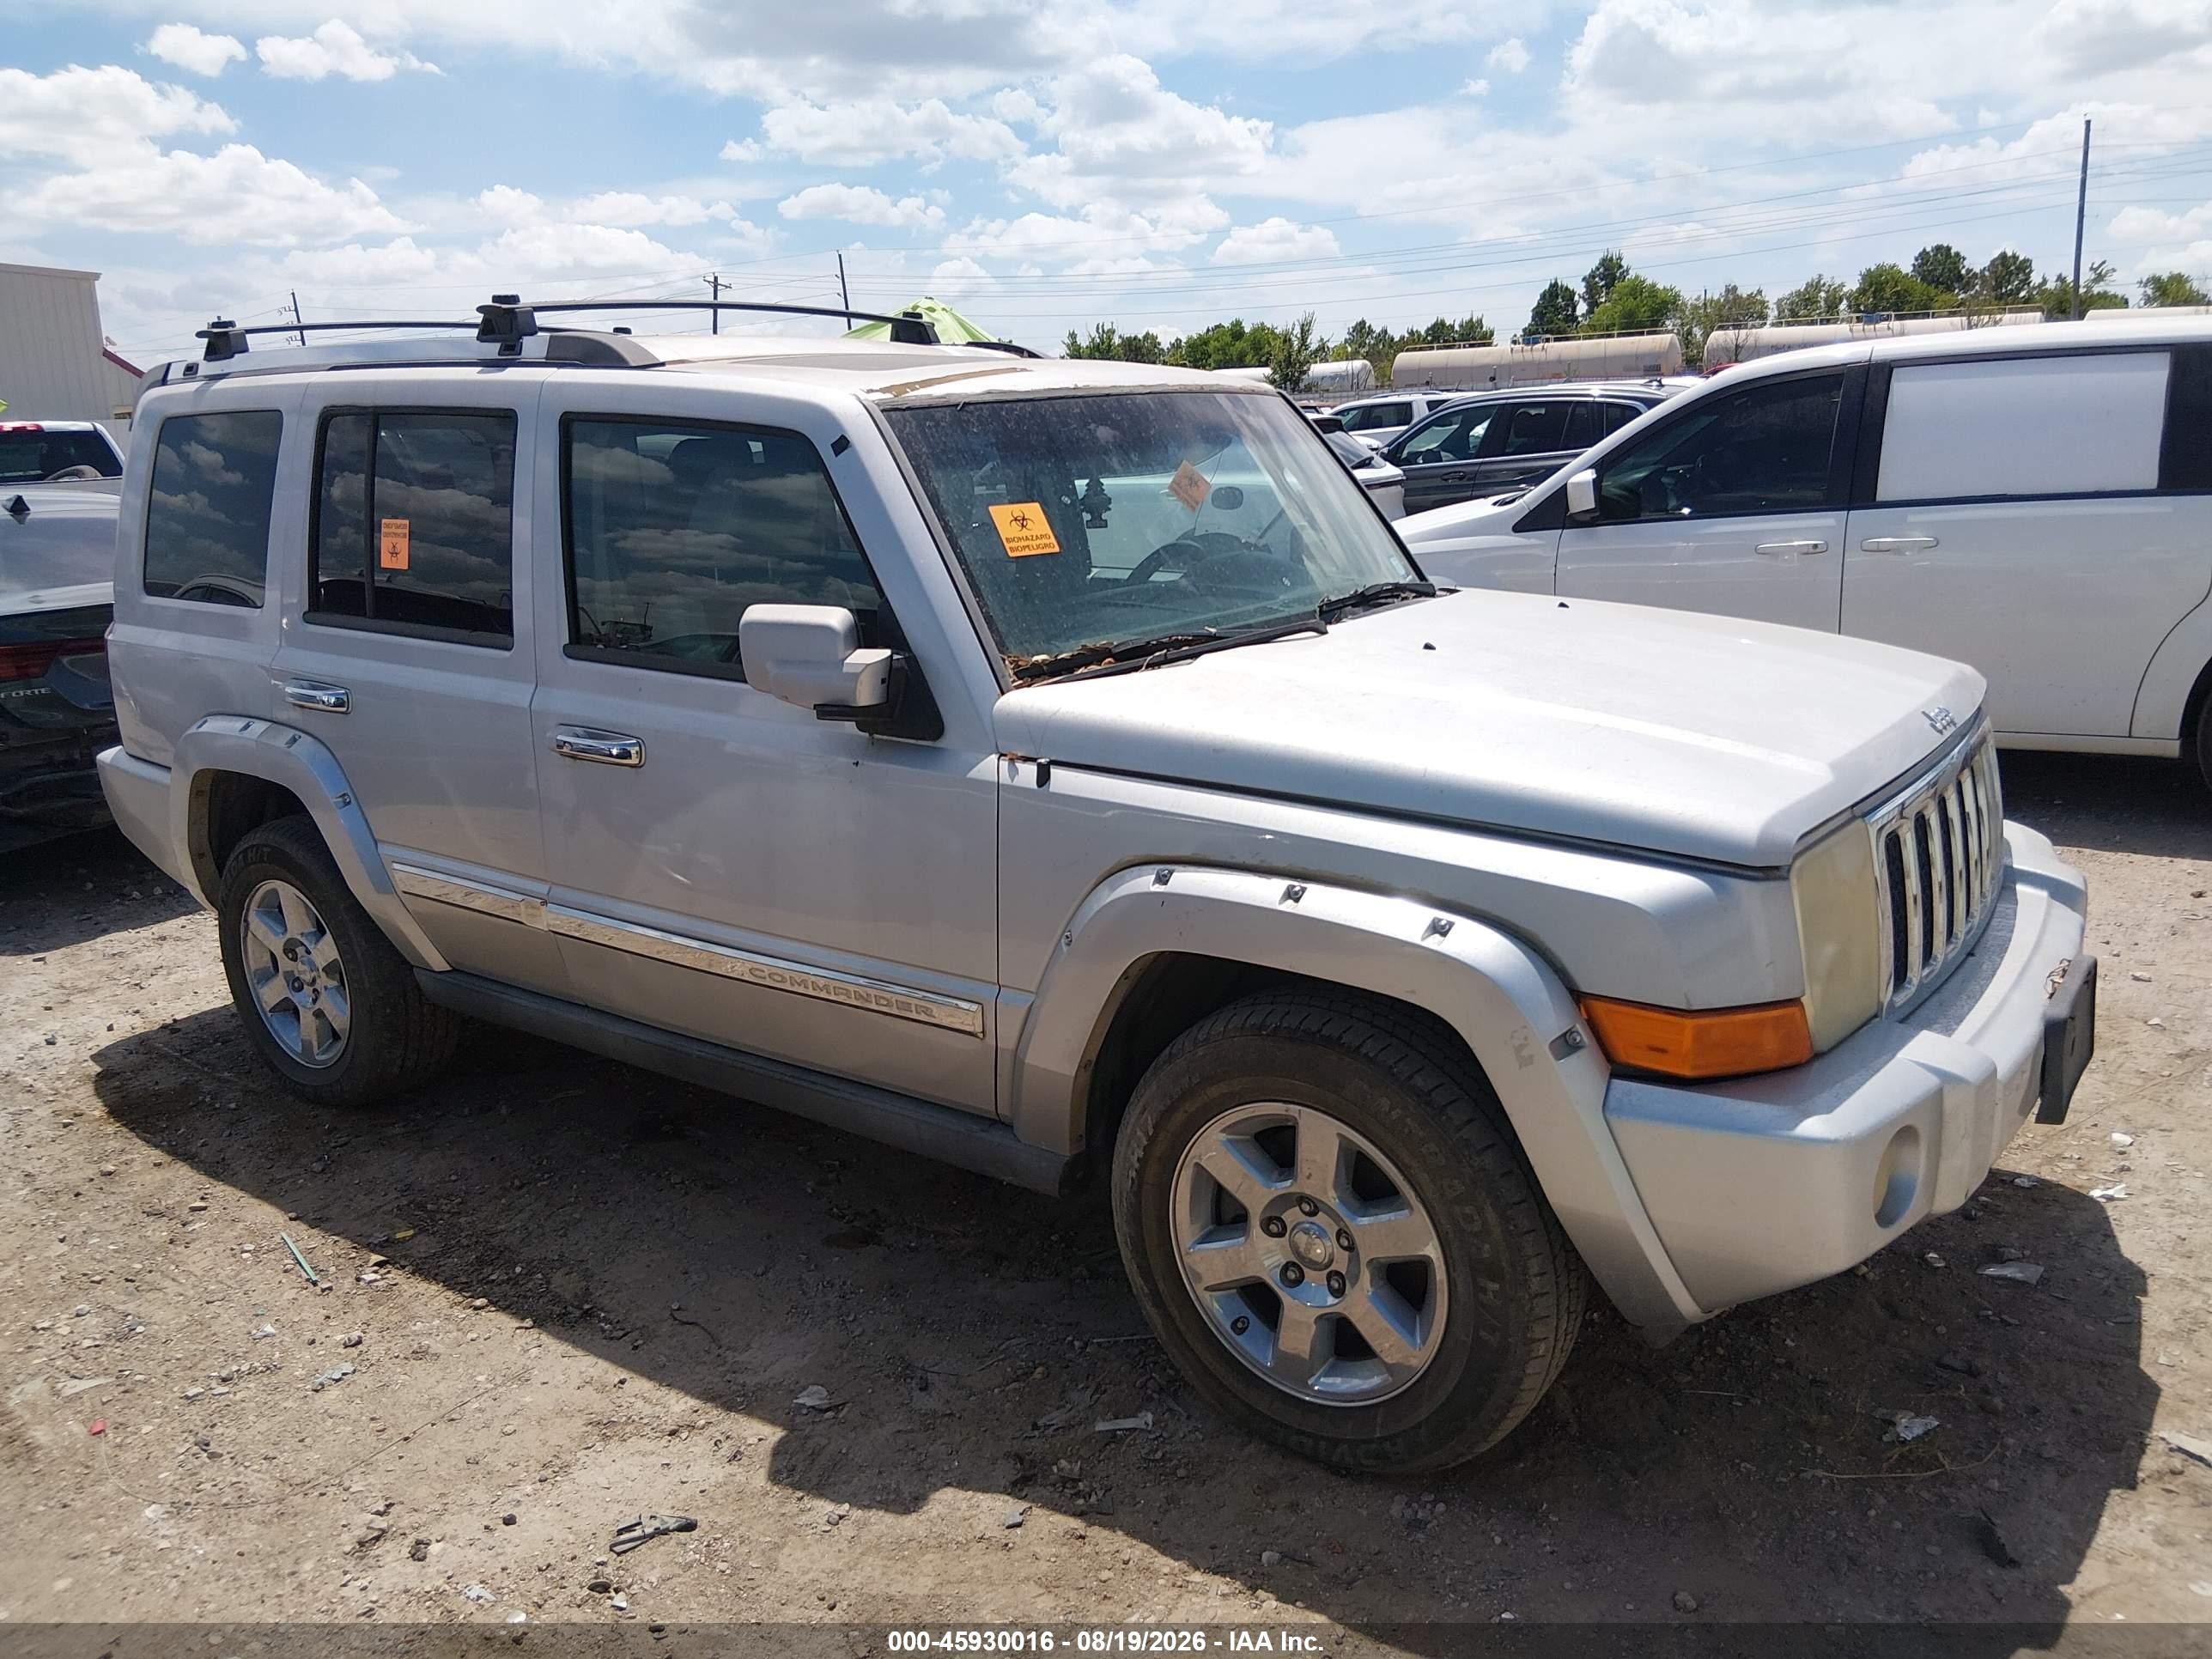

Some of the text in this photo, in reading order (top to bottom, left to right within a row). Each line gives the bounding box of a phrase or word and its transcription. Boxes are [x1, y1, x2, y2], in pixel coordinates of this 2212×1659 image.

[1006, 533, 1051, 544] BIOHAZARD
[1009, 542, 1055, 554] BIOPELIGRO
[0, 687, 52, 699] FORTE
[748, 967, 936, 1018] COMMANDER
